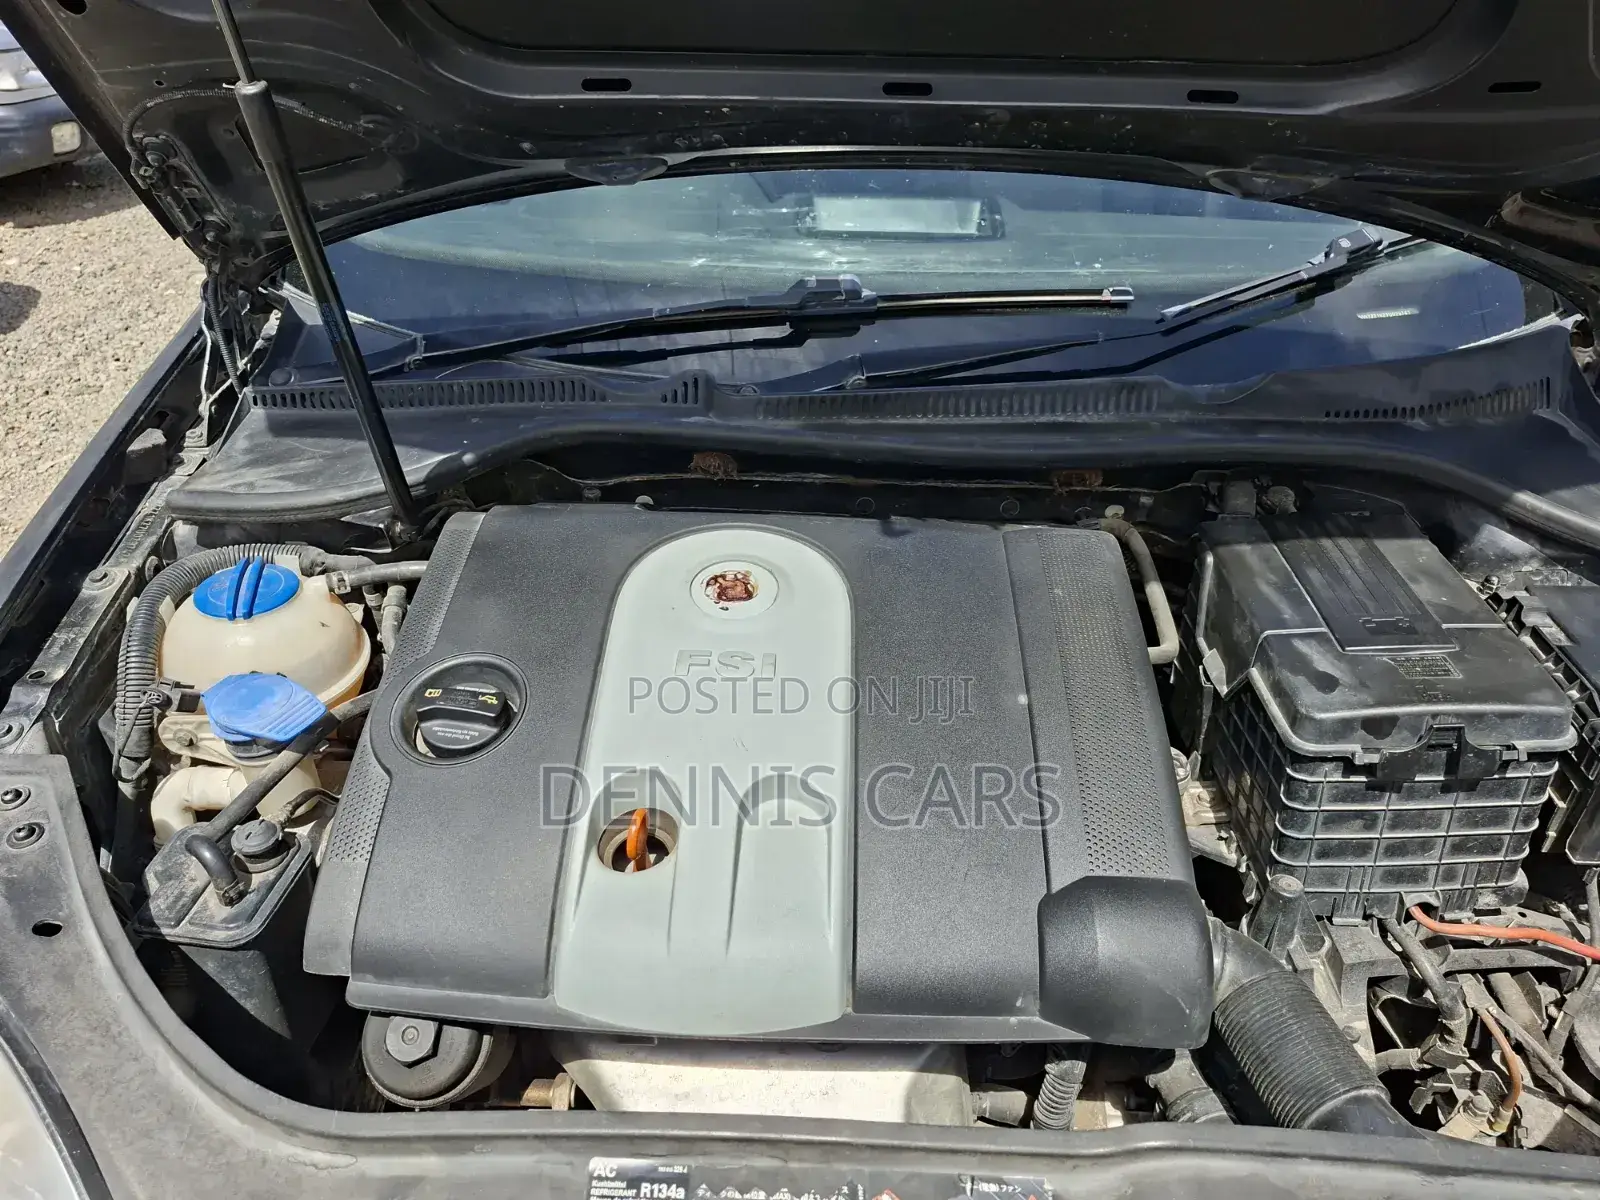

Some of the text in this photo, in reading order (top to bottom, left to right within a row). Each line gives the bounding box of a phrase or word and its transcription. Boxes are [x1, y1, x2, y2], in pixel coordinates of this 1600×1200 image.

[675, 650, 777, 679] FSI
[593, 1161, 618, 1178] AC
[590, 1187, 638, 1197] REFRIGERANT
[640, 1182, 685, 1199] R134a
